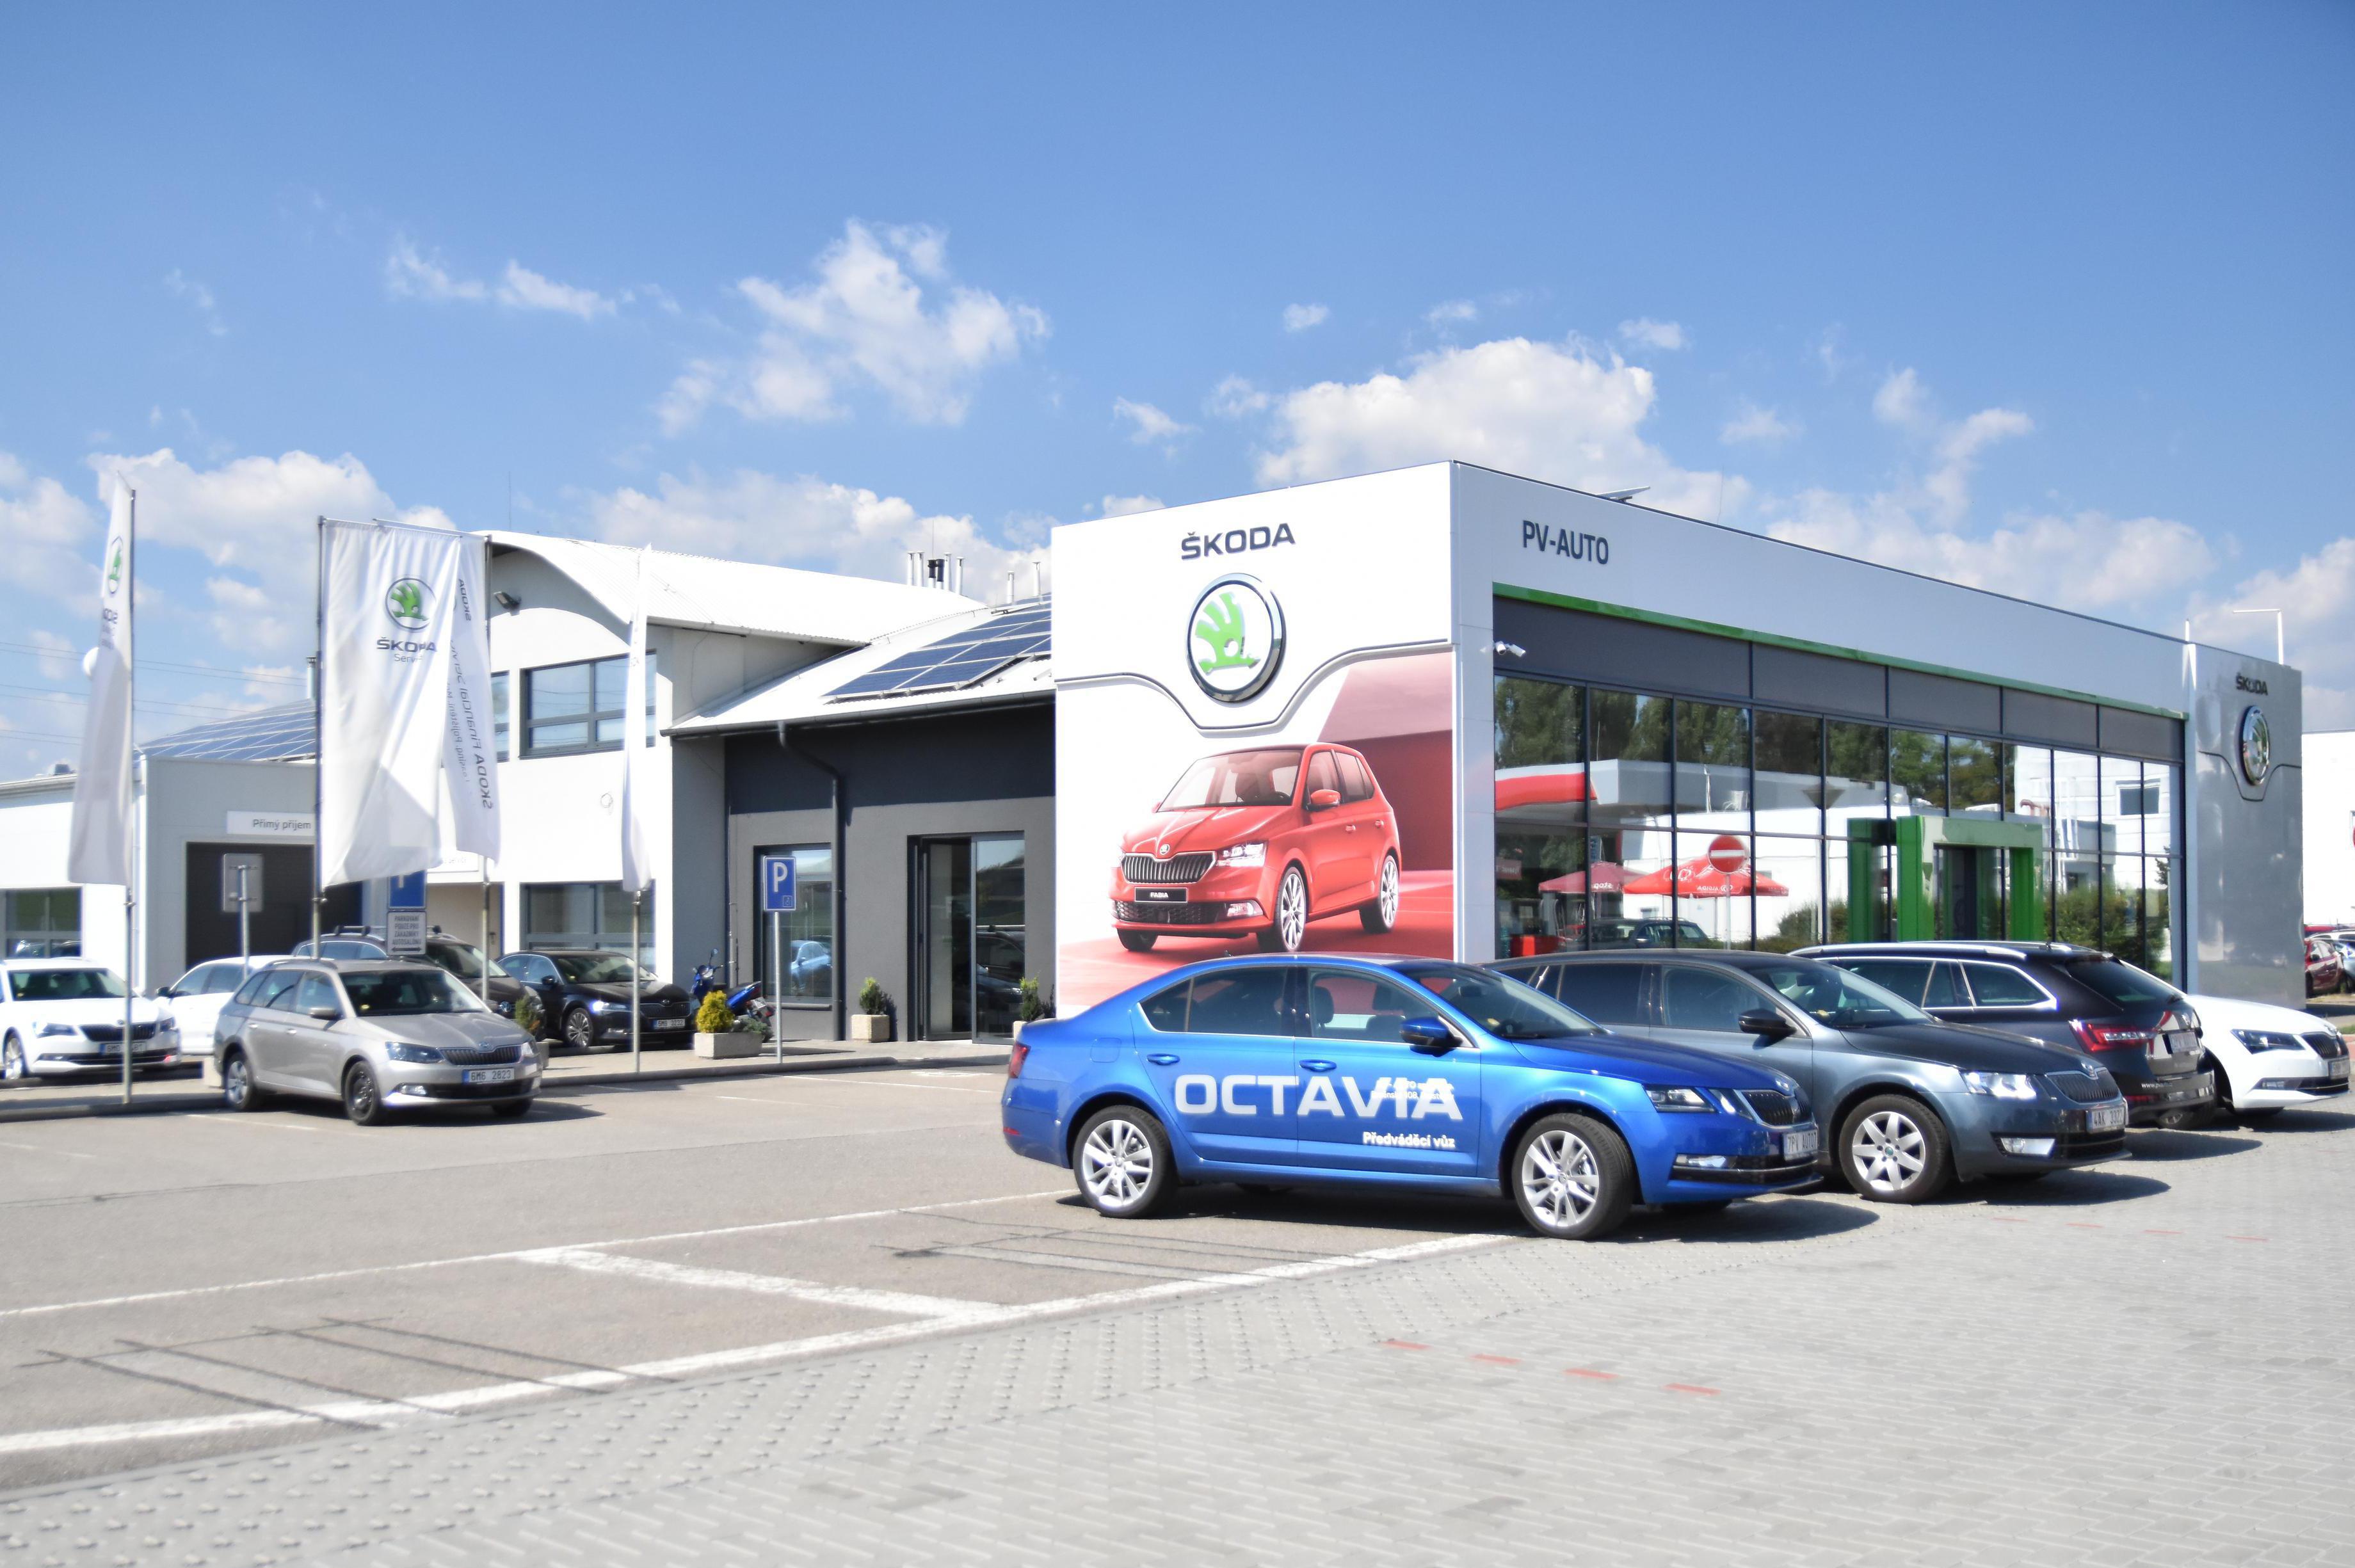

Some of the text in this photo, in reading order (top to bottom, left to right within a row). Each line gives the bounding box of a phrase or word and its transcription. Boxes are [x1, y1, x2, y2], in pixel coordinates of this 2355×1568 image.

[1181, 523, 1296, 561] ŠKODA
[1522, 520, 1609, 565] PV-AUTO
[773, 861, 788, 892] P
[492, 1069, 511, 1080] 2823
[1175, 1075, 1463, 1120] OCTAVIA
[2094, 1110, 2106, 1126] 4AK
[1363, 1131, 1456, 1148] Předváděcí vůz
[1788, 1135, 1799, 1153] 7PV
